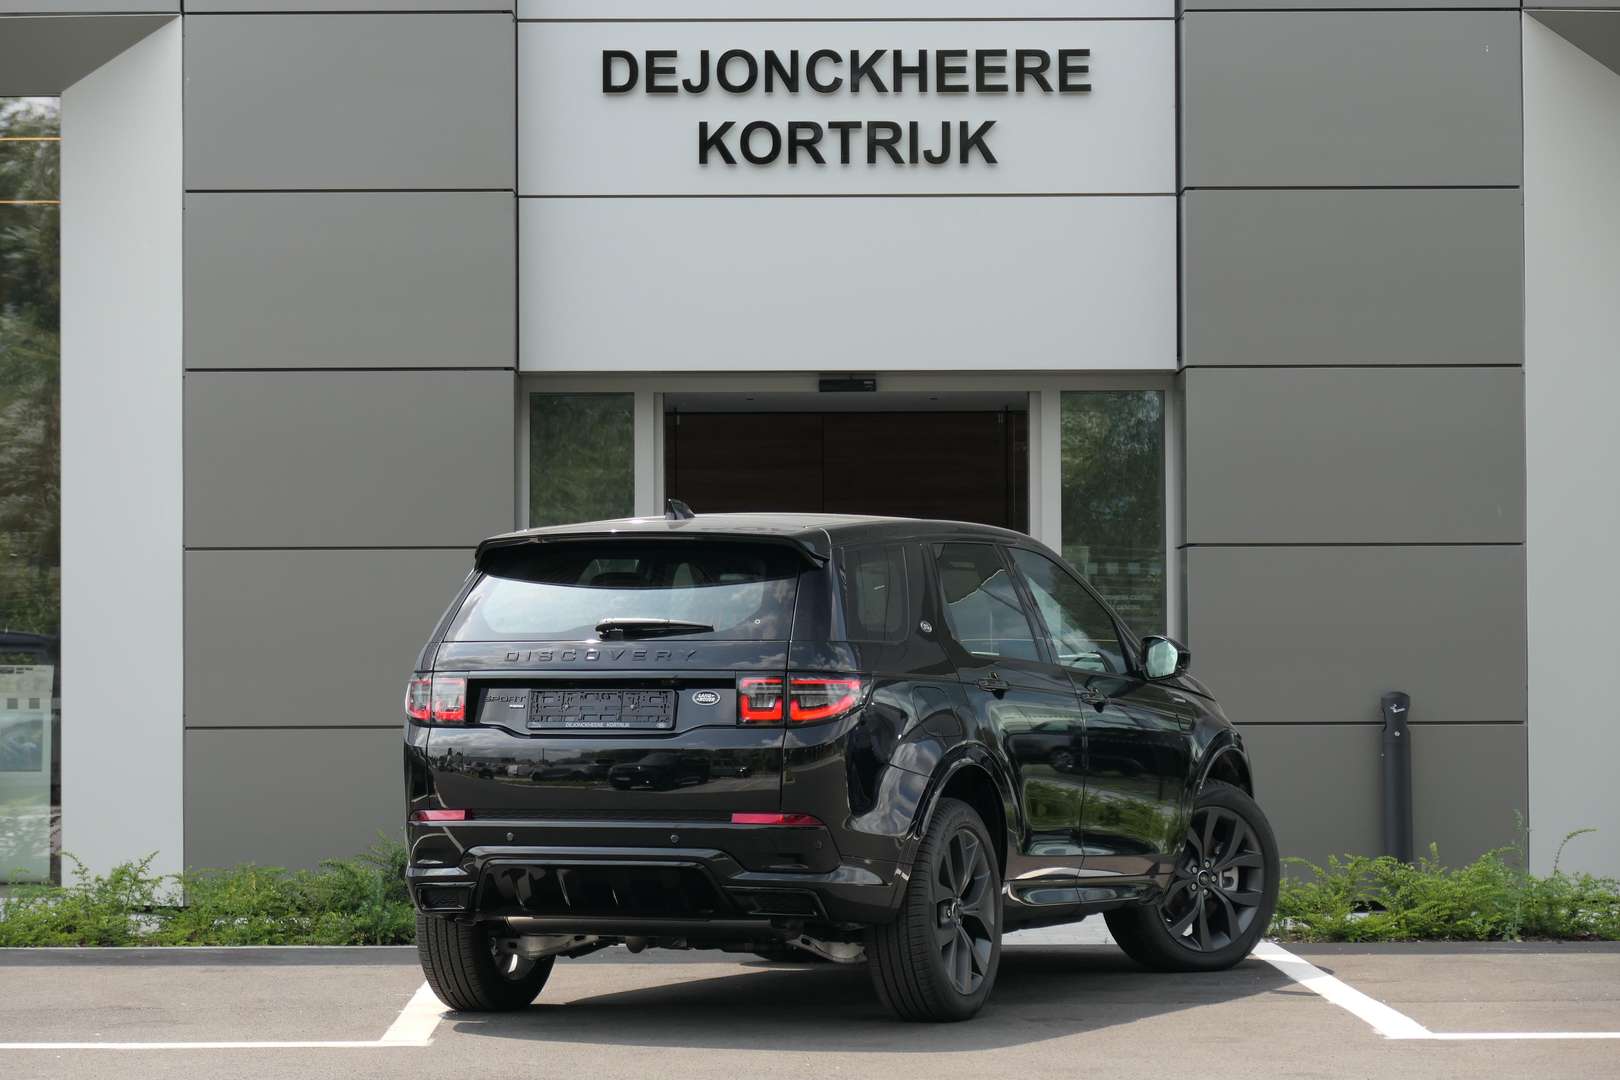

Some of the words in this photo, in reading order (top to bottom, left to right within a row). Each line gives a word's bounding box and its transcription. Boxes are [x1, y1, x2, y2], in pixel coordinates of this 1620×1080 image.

[602, 49, 1092, 95] DEJONCKHEERE
[698, 120, 998, 166] KORTRIJK
[504, 649, 696, 662] DISCOVERY
[485, 695, 526, 703] SPORT
